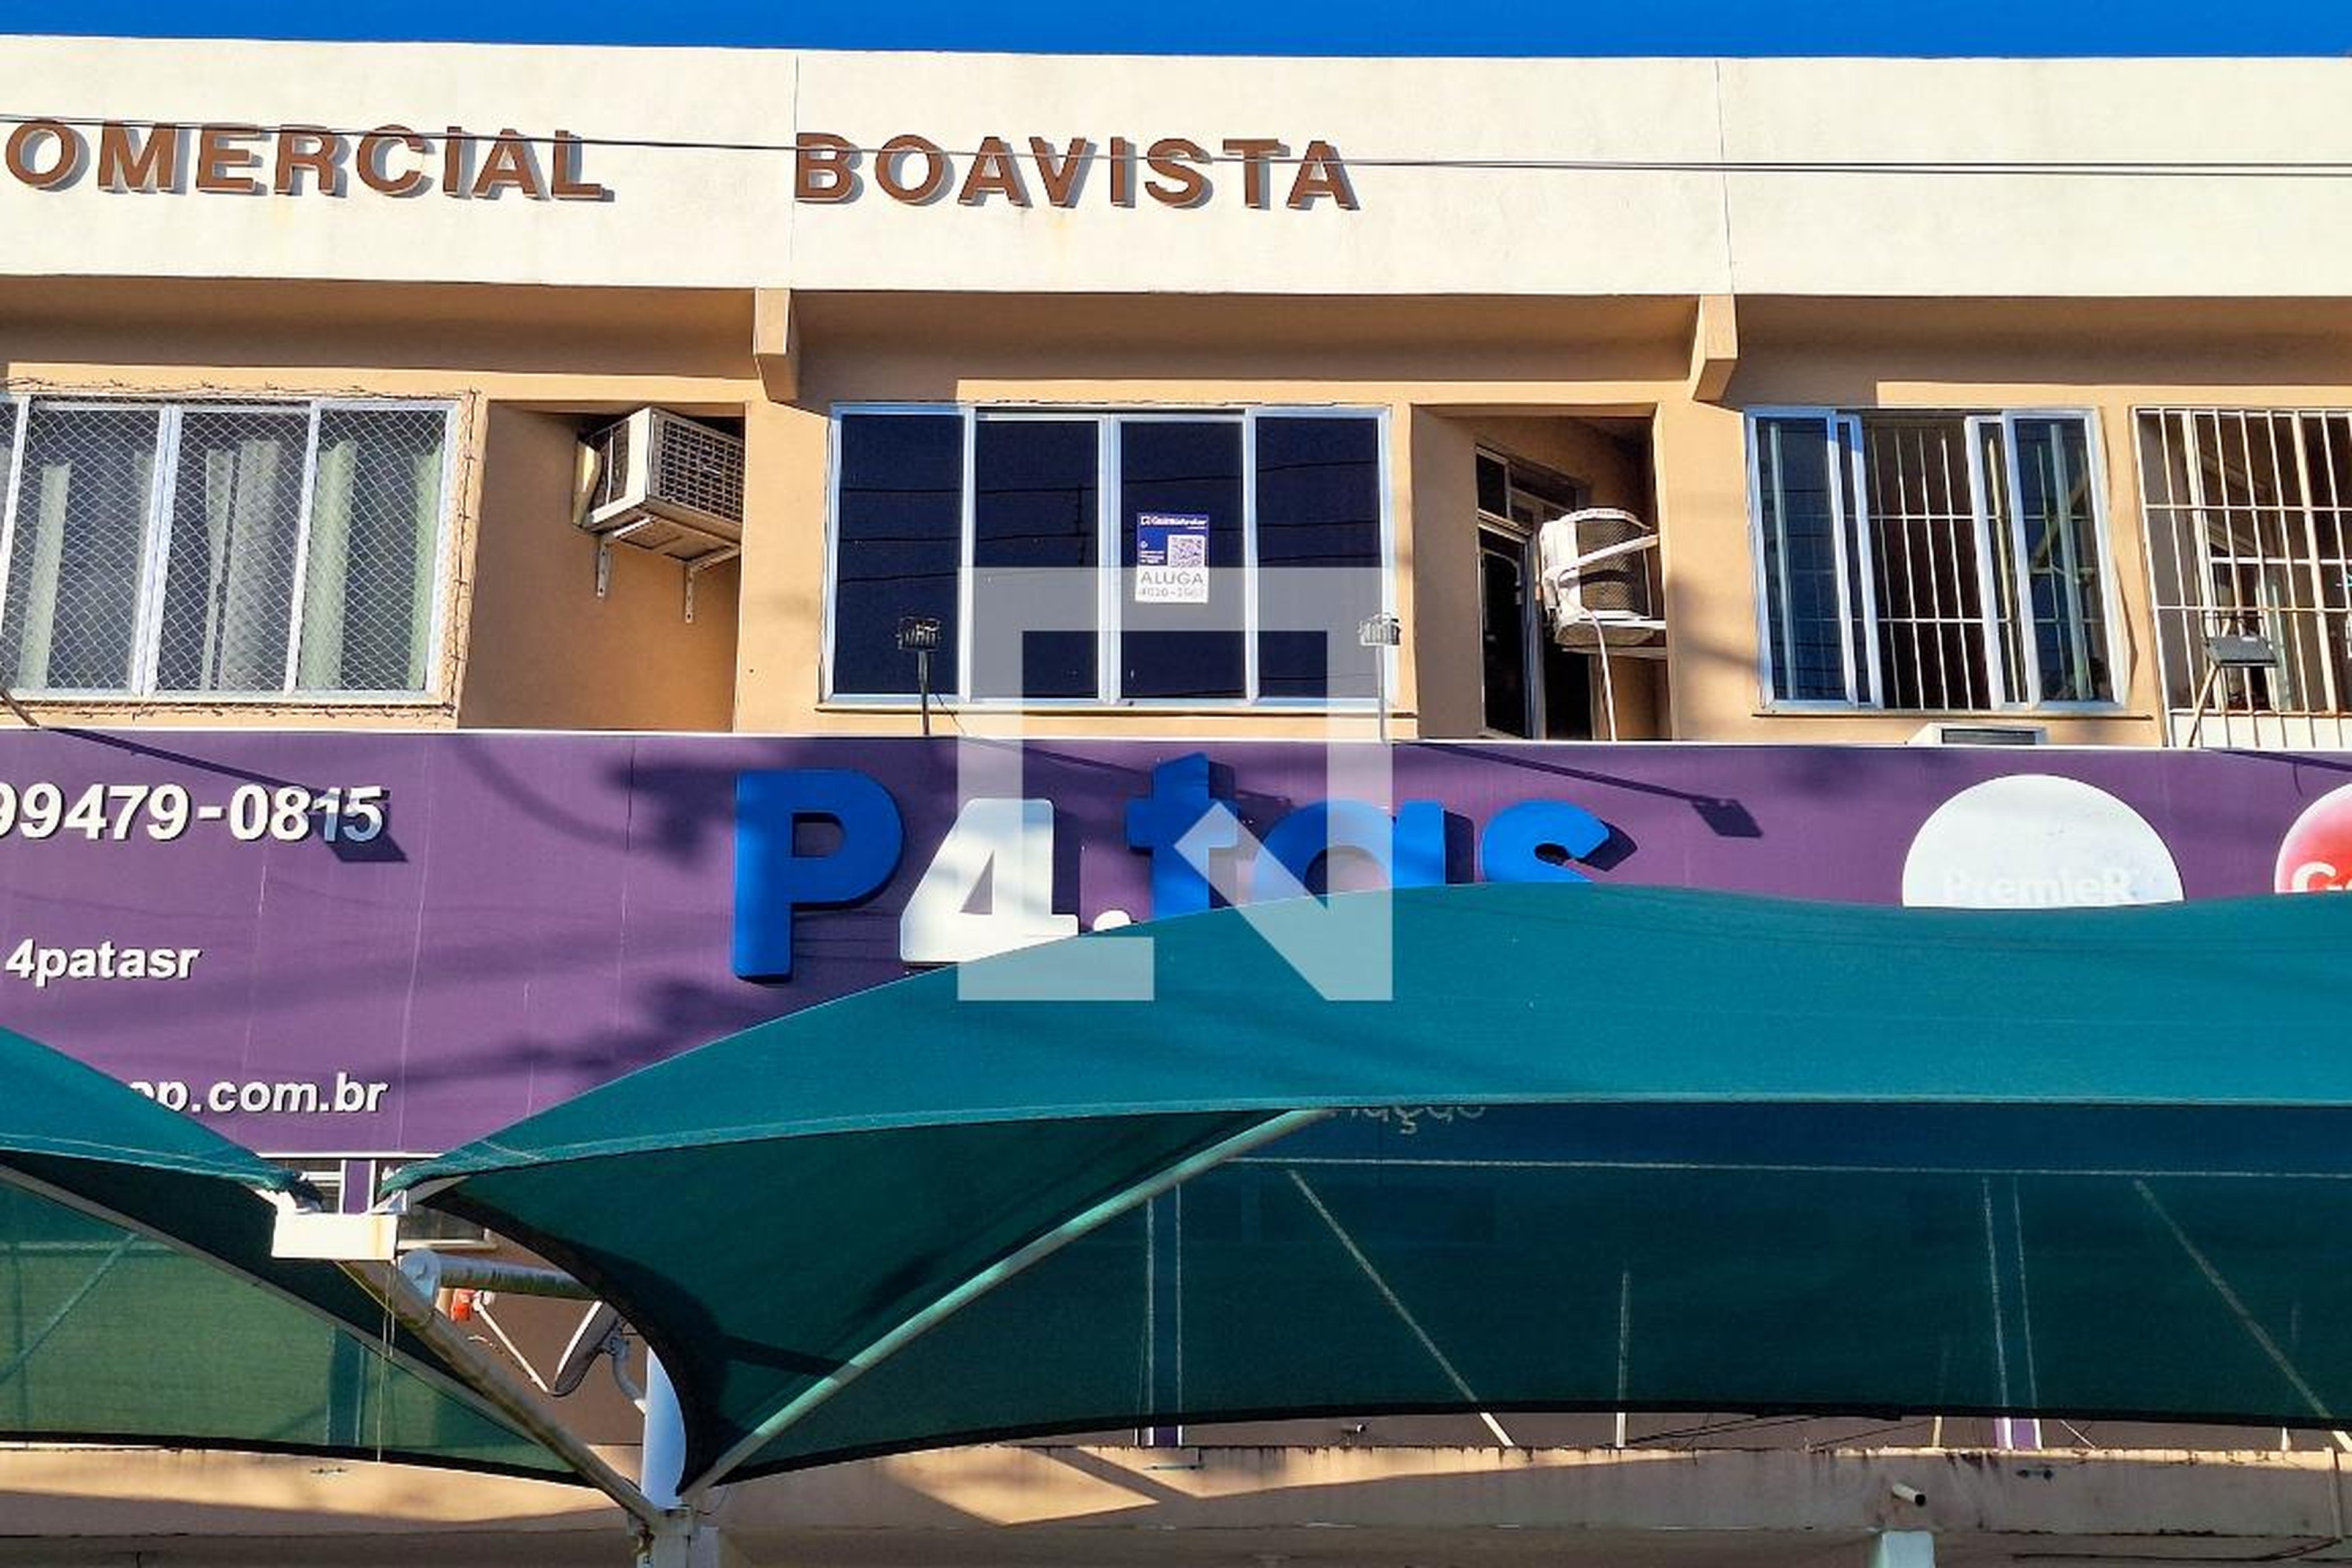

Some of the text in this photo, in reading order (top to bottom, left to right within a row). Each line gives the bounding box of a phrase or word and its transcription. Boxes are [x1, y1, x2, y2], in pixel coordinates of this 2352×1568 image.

[6, 118, 1357, 209] OMERCIAL BOAVISTA
[1140, 571, 1203, 585] ALUGA
[6, 938, 202, 987] 4patasr
